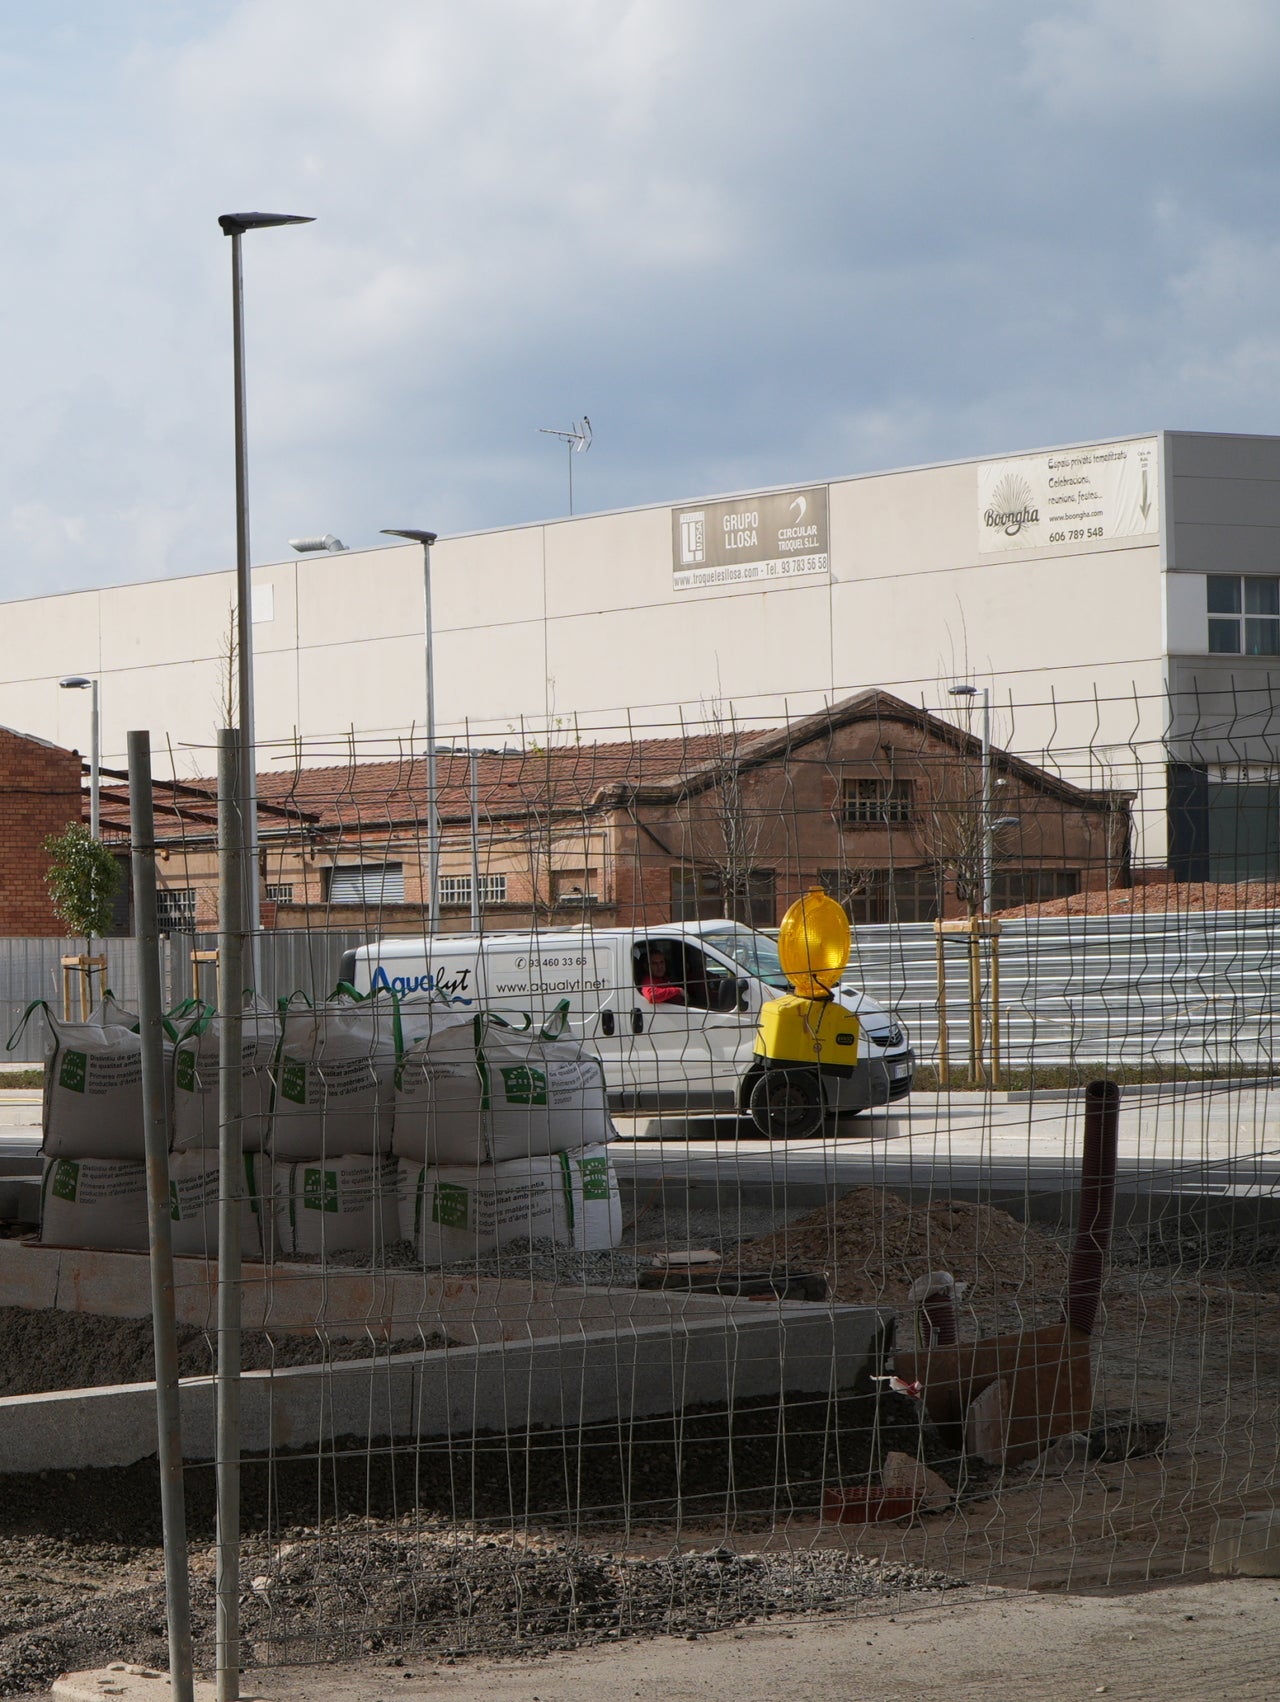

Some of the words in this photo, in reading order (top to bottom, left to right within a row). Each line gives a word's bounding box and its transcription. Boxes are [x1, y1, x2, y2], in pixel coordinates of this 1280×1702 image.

[723, 511, 759, 531] GRUPO
[984, 506, 1040, 536] Boongha
[1049, 510, 1103, 522] www.boongha.com
[725, 530, 758, 549] LLOSA
[778, 525, 818, 539] CIRCULAR
[1049, 531, 1065, 542] 606
[1068, 530, 1084, 540] 789
[1087, 527, 1103, 538] 548
[778, 538, 804, 552] TROQUEL
[674, 567, 759, 587] www.troquelesllosa.com
[765, 562, 780, 576] Tel.
[782, 560, 790, 574] 93
[792, 558, 805, 572] 783
[807, 557, 816, 570] 56
[818, 556, 826, 569] 58
[542, 958, 560, 967] 460
[562, 957, 573, 966] 33
[371, 966, 471, 998] Aqualyt
[496, 978, 605, 994] www.aqualytnet
[90, 1054, 116, 1062] Distintiu
[127, 1051, 141, 1061] gara
[98, 1062, 122, 1070] qualitat
